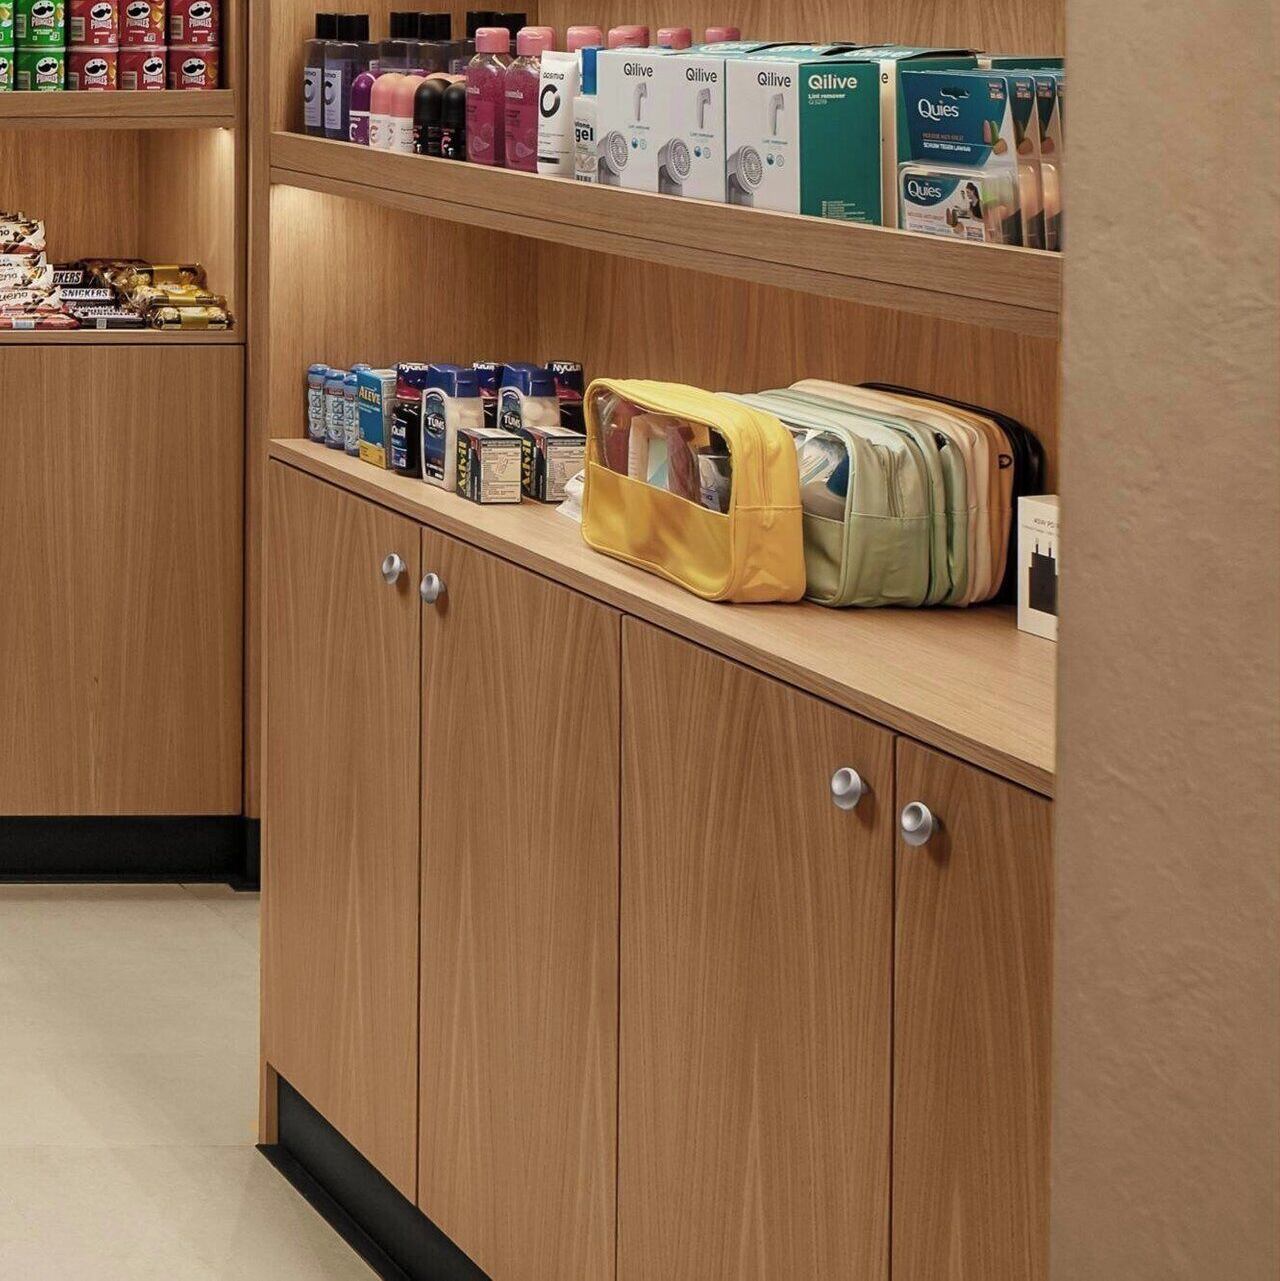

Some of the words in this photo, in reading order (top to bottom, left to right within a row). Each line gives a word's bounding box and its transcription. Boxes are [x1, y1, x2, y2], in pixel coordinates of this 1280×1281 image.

[624, 62, 653, 77] Qilive
[686, 68, 718, 82] Qilive
[757, 72, 791, 88] Qilive
[808, 74, 858, 90] Qilive
[918, 98, 960, 121] Quies
[576, 127, 594, 142] gel
[908, 180, 942, 200] Quies
[52, 272, 81, 283] CKERS
[62, 289, 108, 298] SNICKERS
[428, 417, 445, 430] TUMS
[504, 414, 520, 426] TUMS
[458, 440, 467, 488] Advil
[522, 439, 532, 486] Advil
